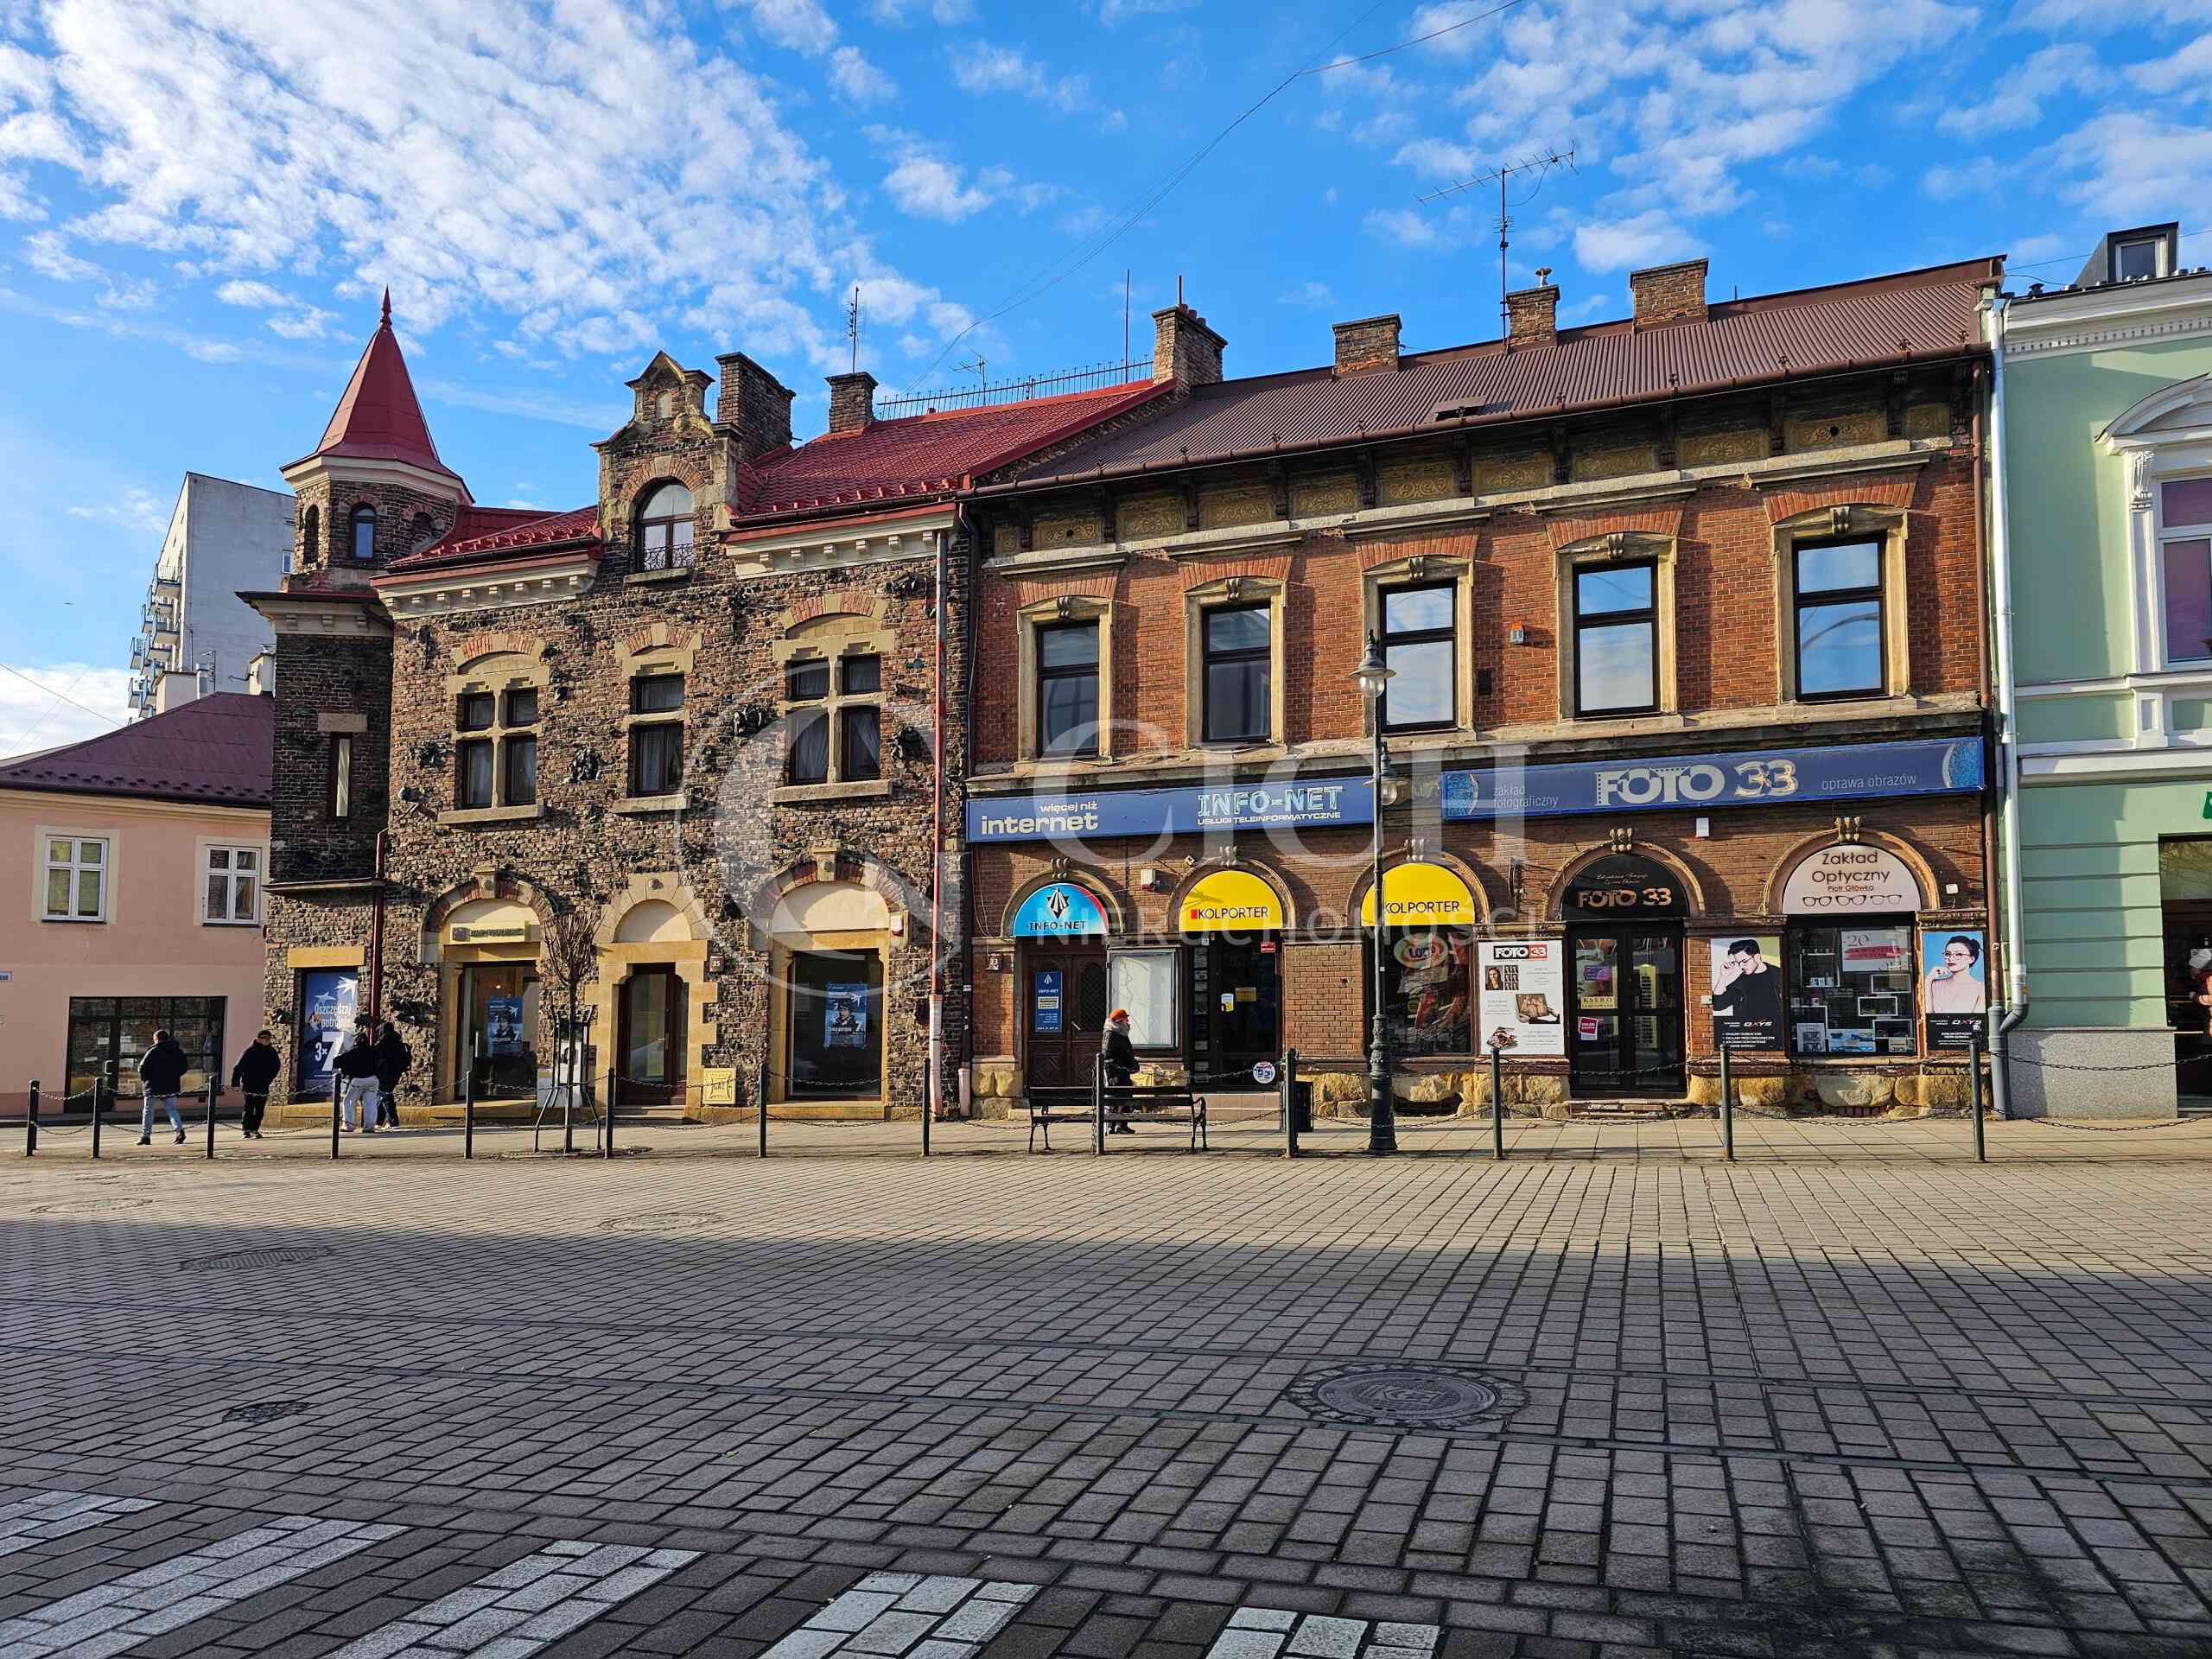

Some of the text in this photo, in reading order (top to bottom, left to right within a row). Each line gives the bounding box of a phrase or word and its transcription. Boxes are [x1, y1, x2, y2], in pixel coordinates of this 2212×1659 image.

[1594, 760, 1798, 805] FOTO 33
[1821, 773, 1916, 791] oprawa obrazów
[1039, 801, 1098, 813] więcej niż
[1198, 786, 1344, 817] INFO-NET
[1494, 795, 1559, 810] fotograficzny
[982, 812, 1098, 835] internet
[1233, 812, 1341, 823] TELEINFORMATYCZNE
[1822, 851, 1878, 864] Zakład
[1812, 870, 1890, 884] Optyczny
[1577, 888, 1673, 907] FOTO 33
[1198, 906, 1269, 919] KOLPORTER
[1030, 920, 1086, 931] INFO-NET
[1495, 947, 1547, 957] FOTO 33
